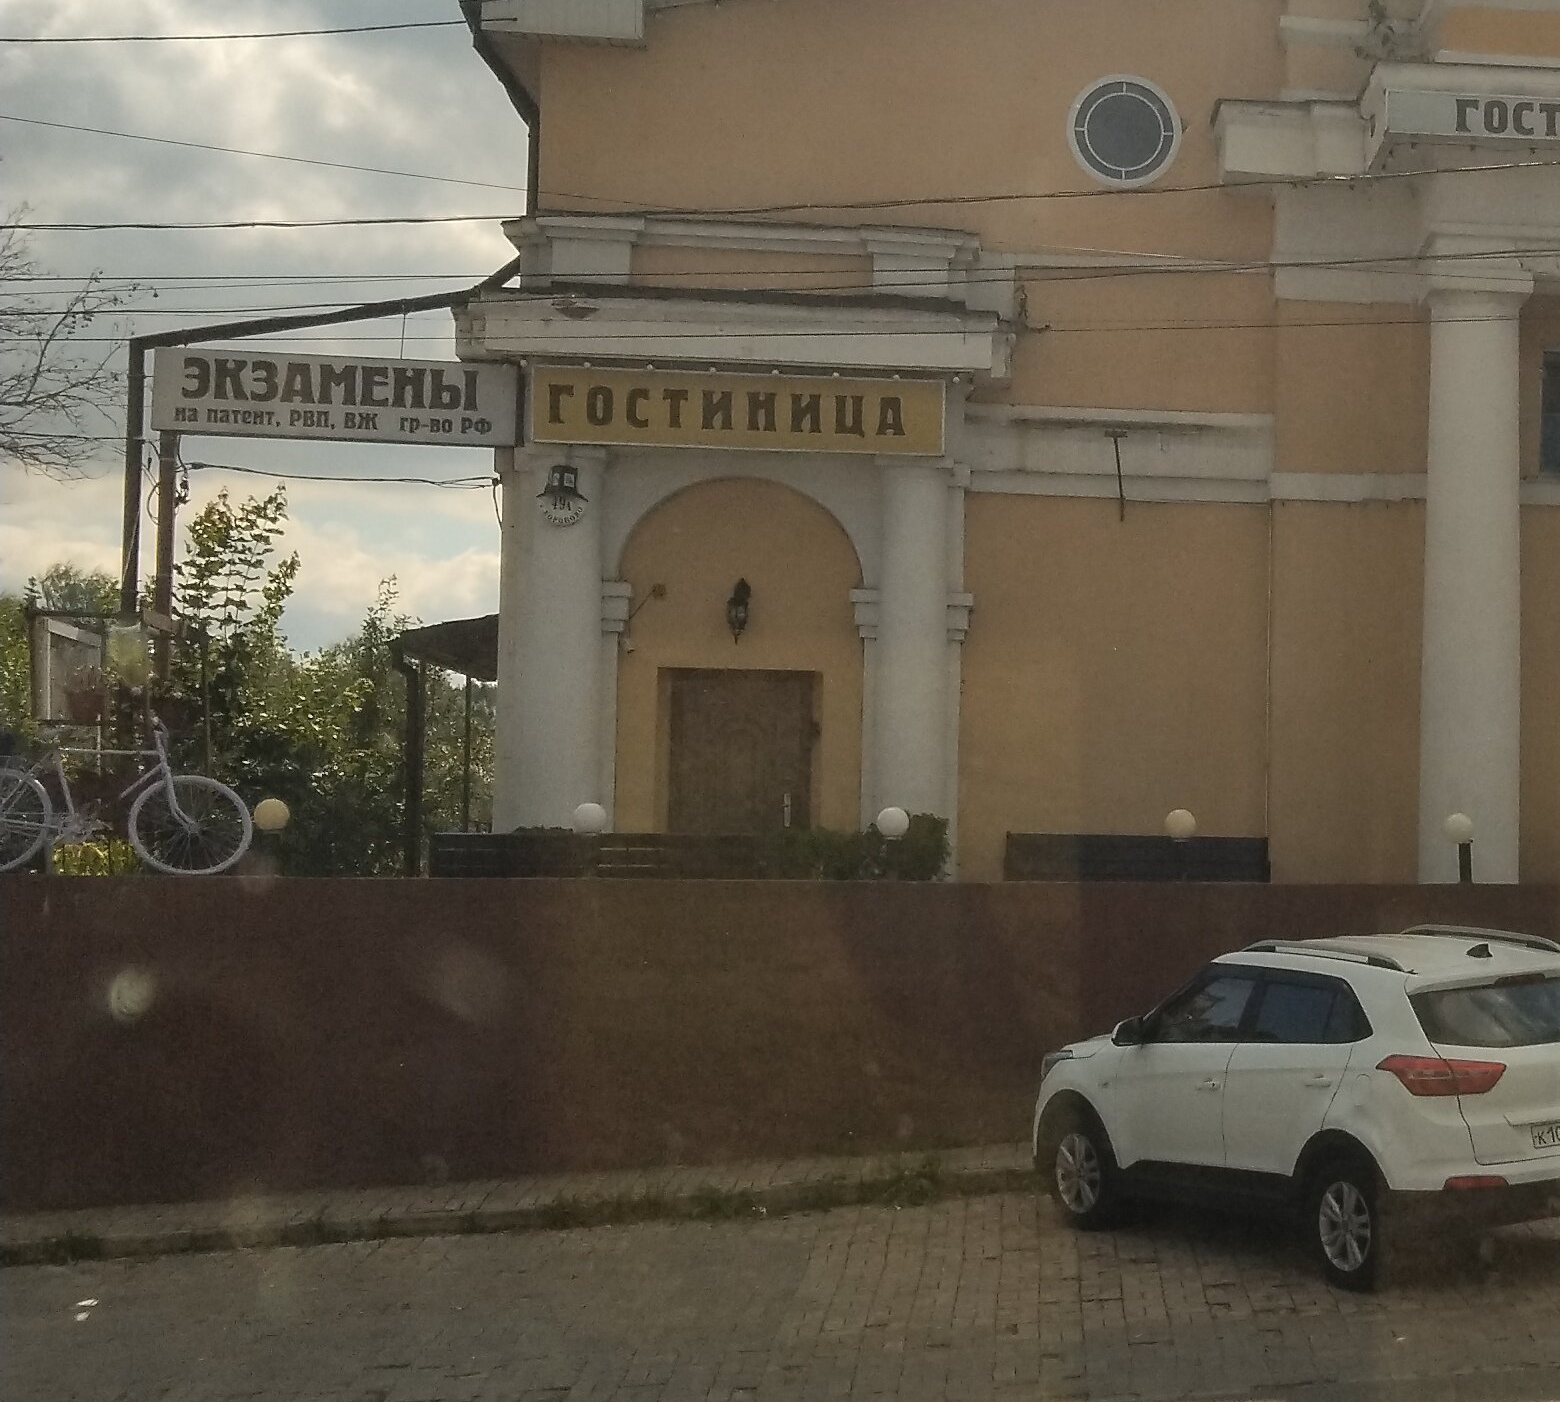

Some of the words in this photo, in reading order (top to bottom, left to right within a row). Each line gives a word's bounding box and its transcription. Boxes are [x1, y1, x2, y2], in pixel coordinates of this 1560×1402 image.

[181, 357, 479, 412] ЭКЗАМЕНЫ
[547, 383, 907, 438] ГОСТИНИЦА
[206, 408, 281, 427] патент,
[289, 409, 336, 430] РВП,
[344, 411, 379, 431] ВЖ
[461, 416, 493, 435] РФ
